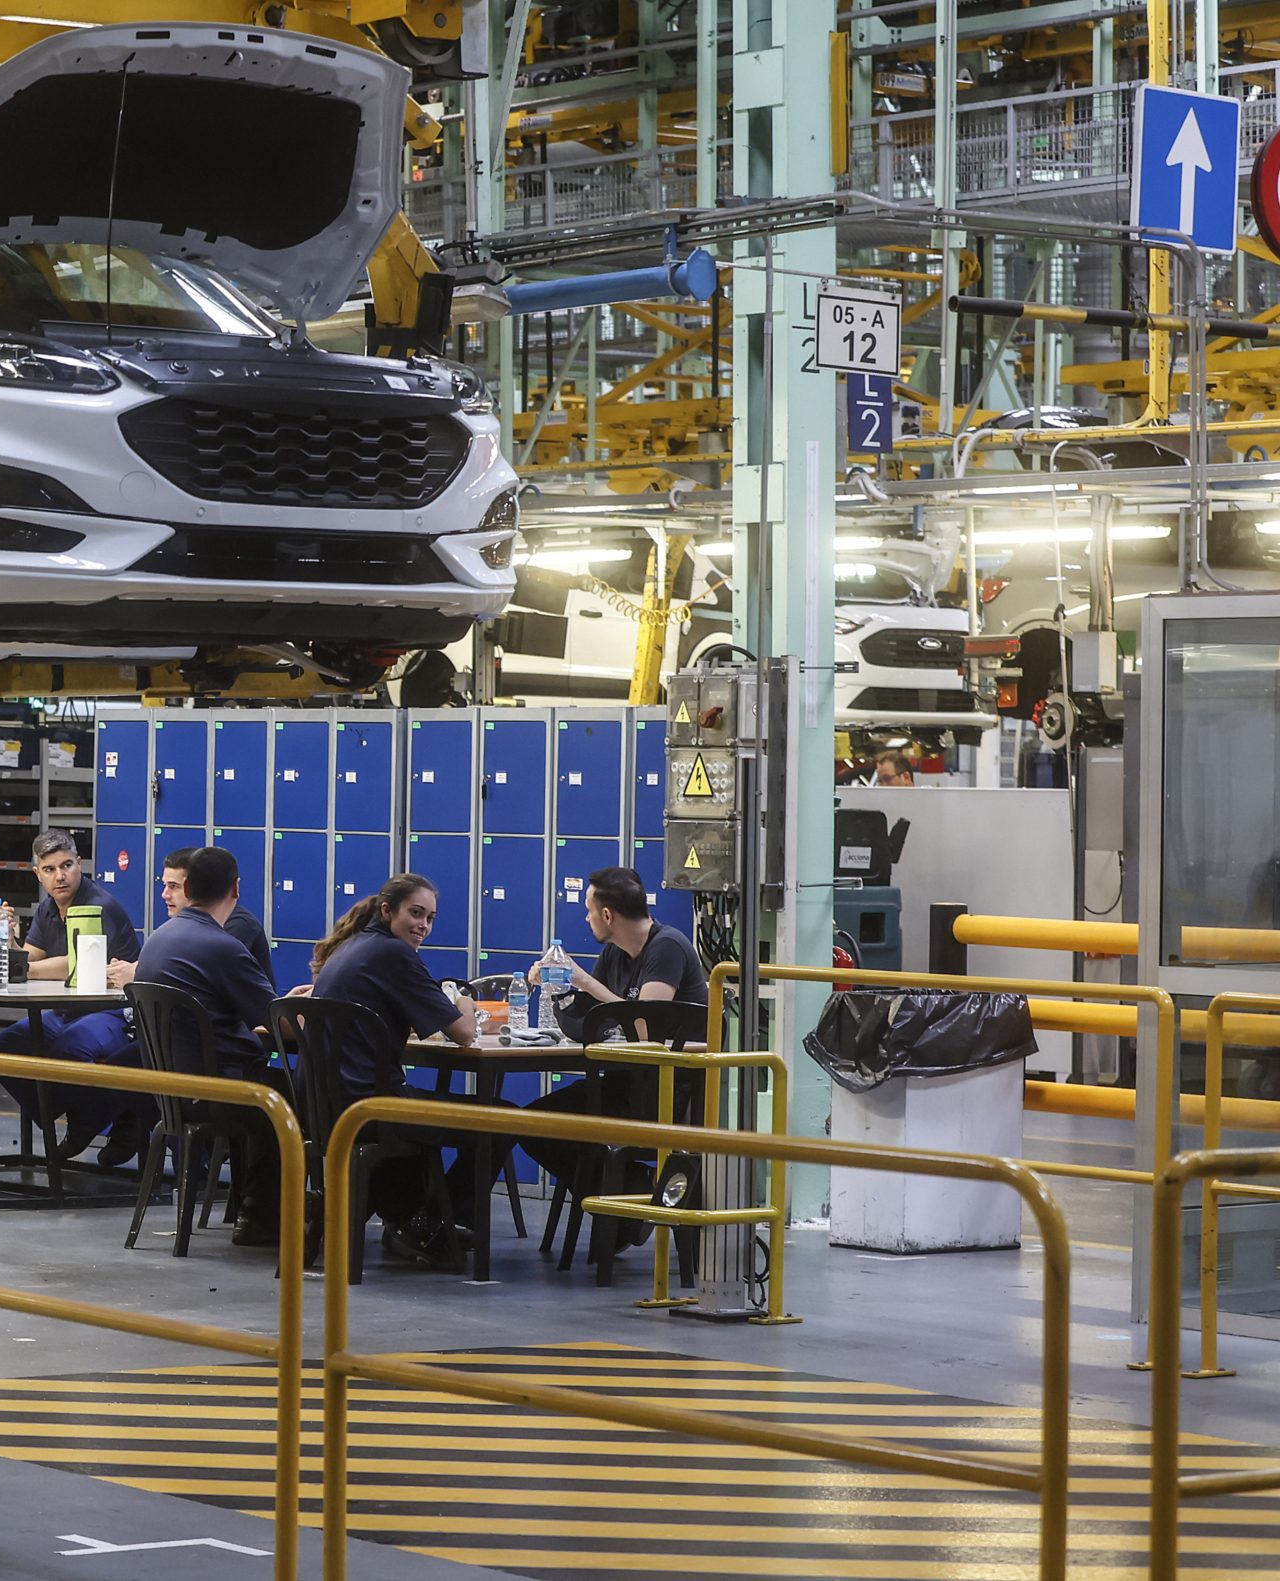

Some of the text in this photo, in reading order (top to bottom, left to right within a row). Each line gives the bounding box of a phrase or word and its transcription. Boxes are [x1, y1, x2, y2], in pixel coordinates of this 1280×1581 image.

[833, 305, 855, 325] 05
[871, 310, 885, 329] A
[842, 330, 877, 364] 12
[861, 408, 881, 448] 2
